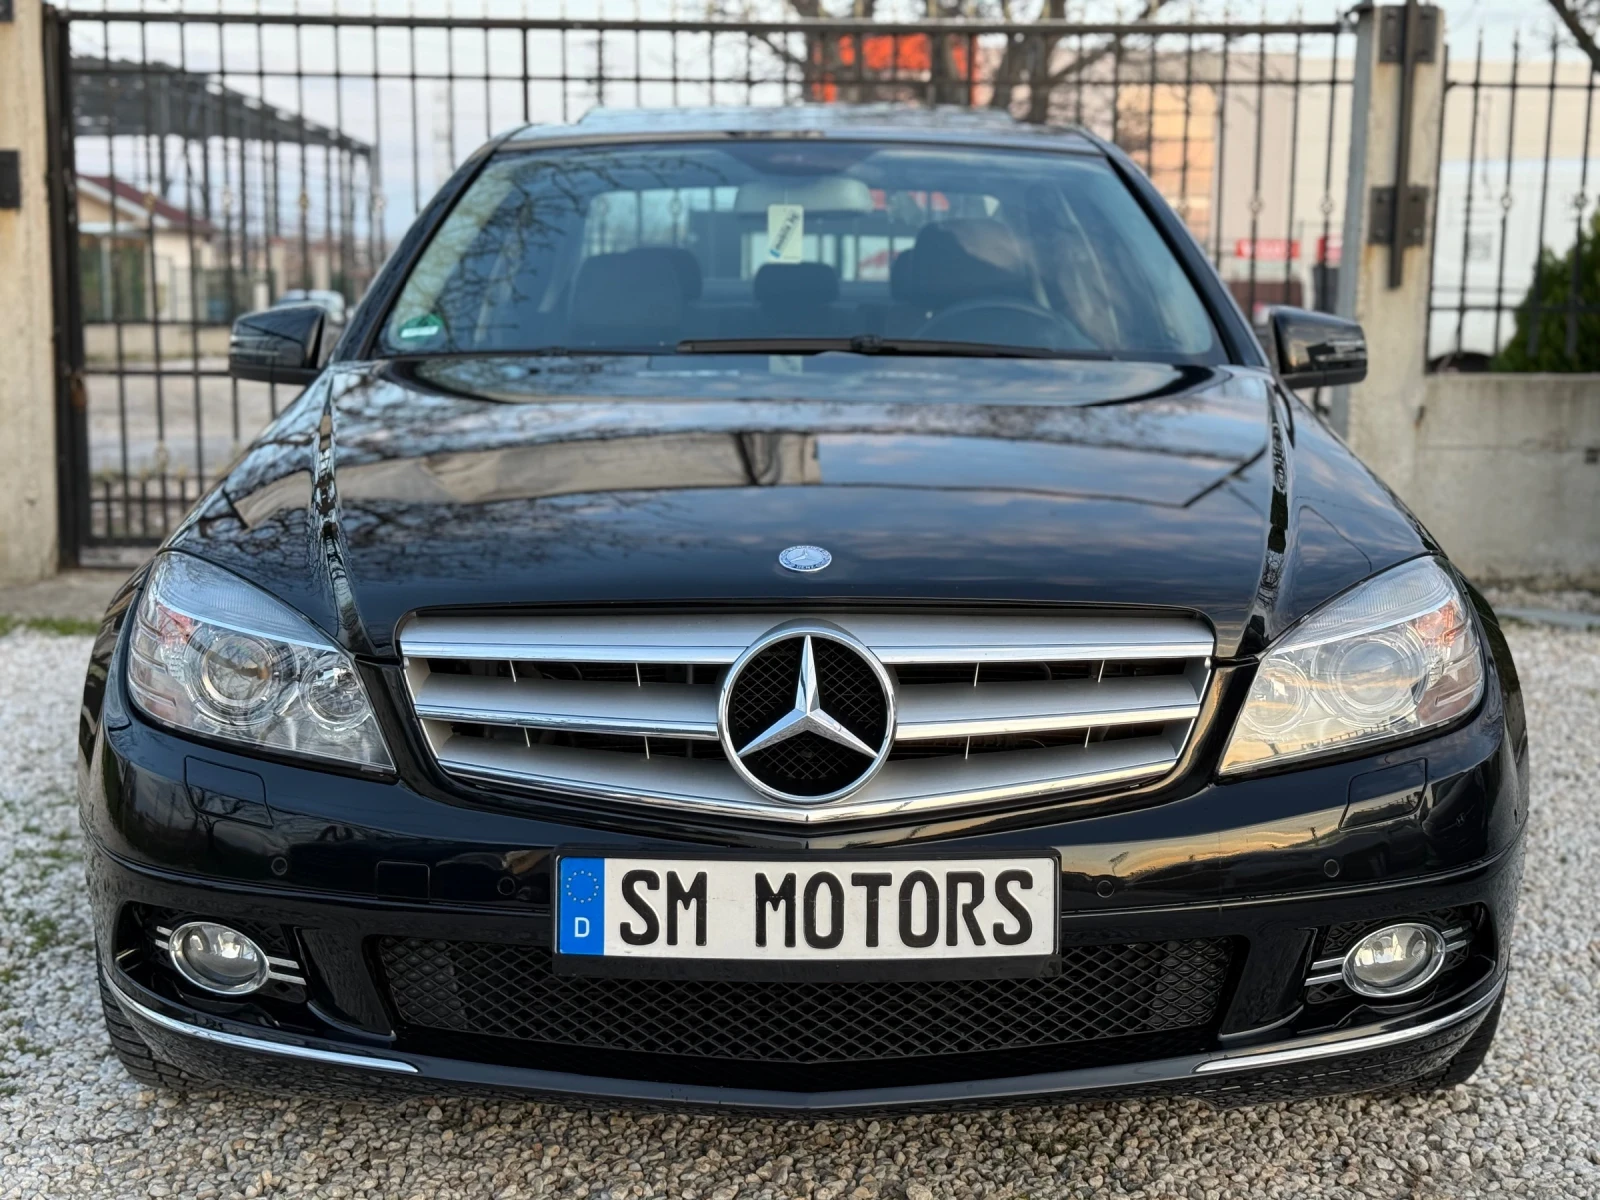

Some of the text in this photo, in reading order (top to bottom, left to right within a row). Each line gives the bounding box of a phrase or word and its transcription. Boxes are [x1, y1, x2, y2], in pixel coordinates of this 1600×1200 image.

[574, 916, 590, 938] D
[619, 868, 1034, 948] SM MOTORS
